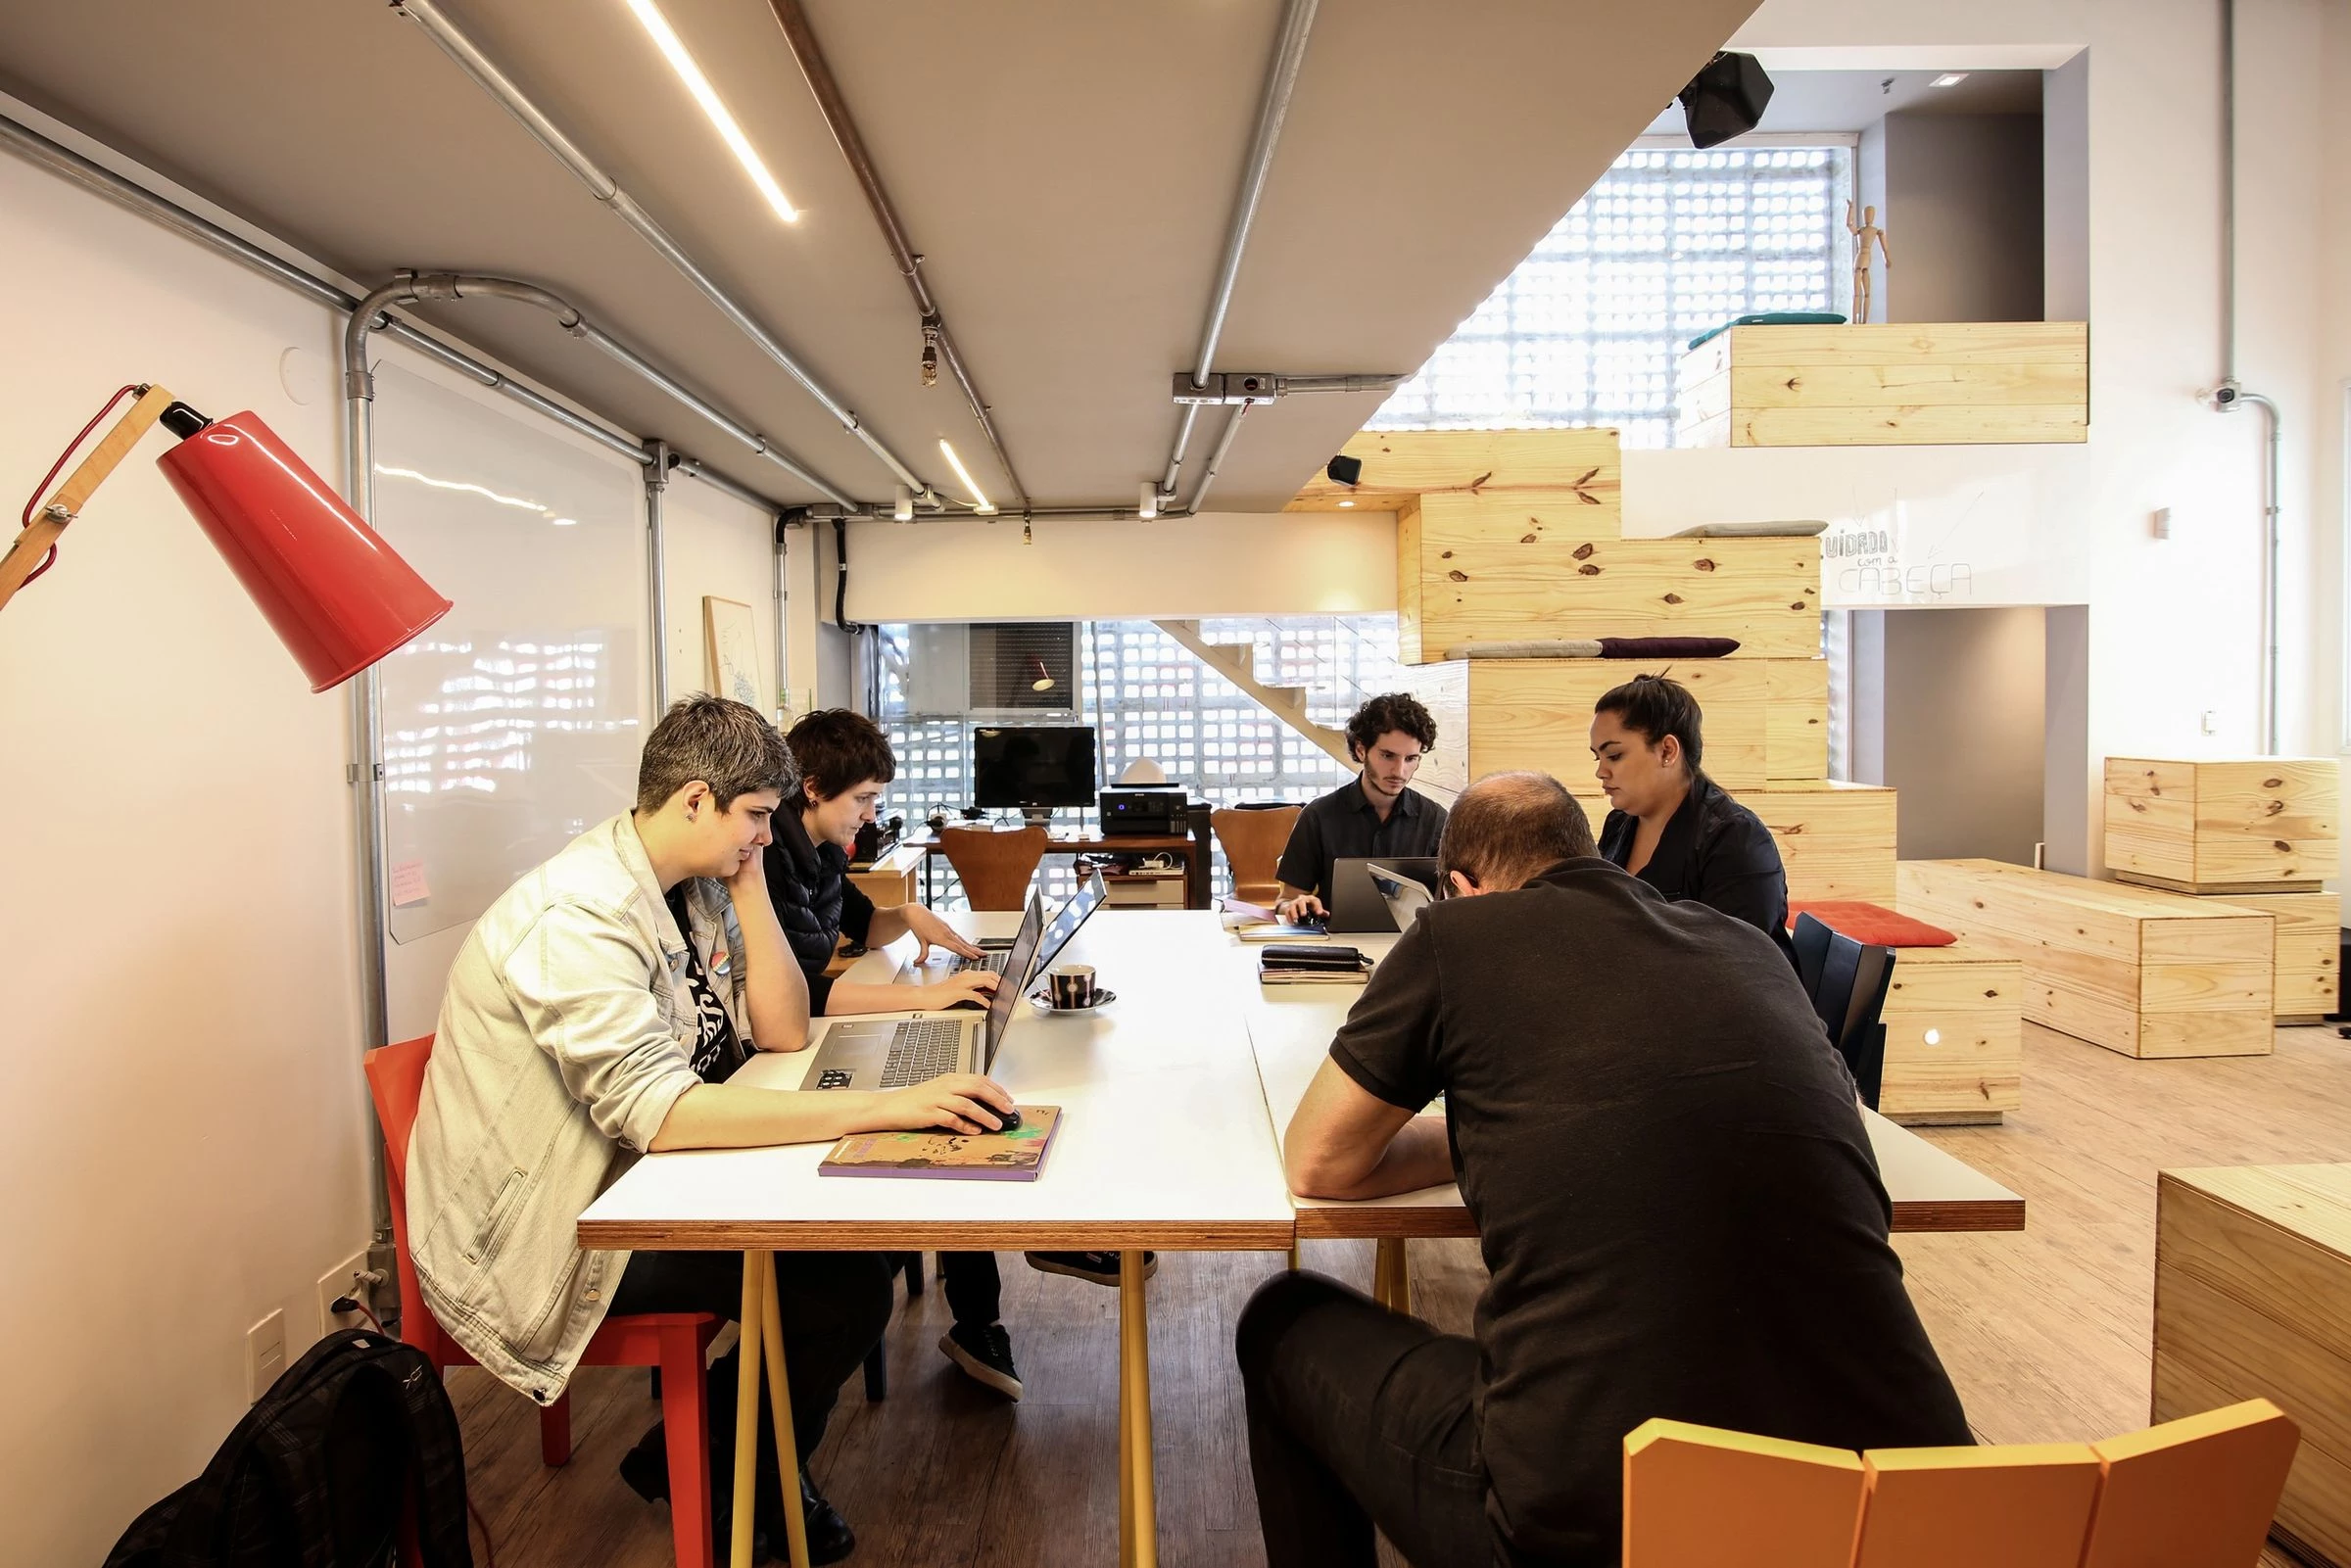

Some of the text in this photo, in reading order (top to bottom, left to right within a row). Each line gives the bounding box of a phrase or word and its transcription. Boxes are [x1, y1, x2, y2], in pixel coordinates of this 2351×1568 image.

[1857, 556, 1898, 567] com a
[1839, 563, 1972, 600] CABEÇA
